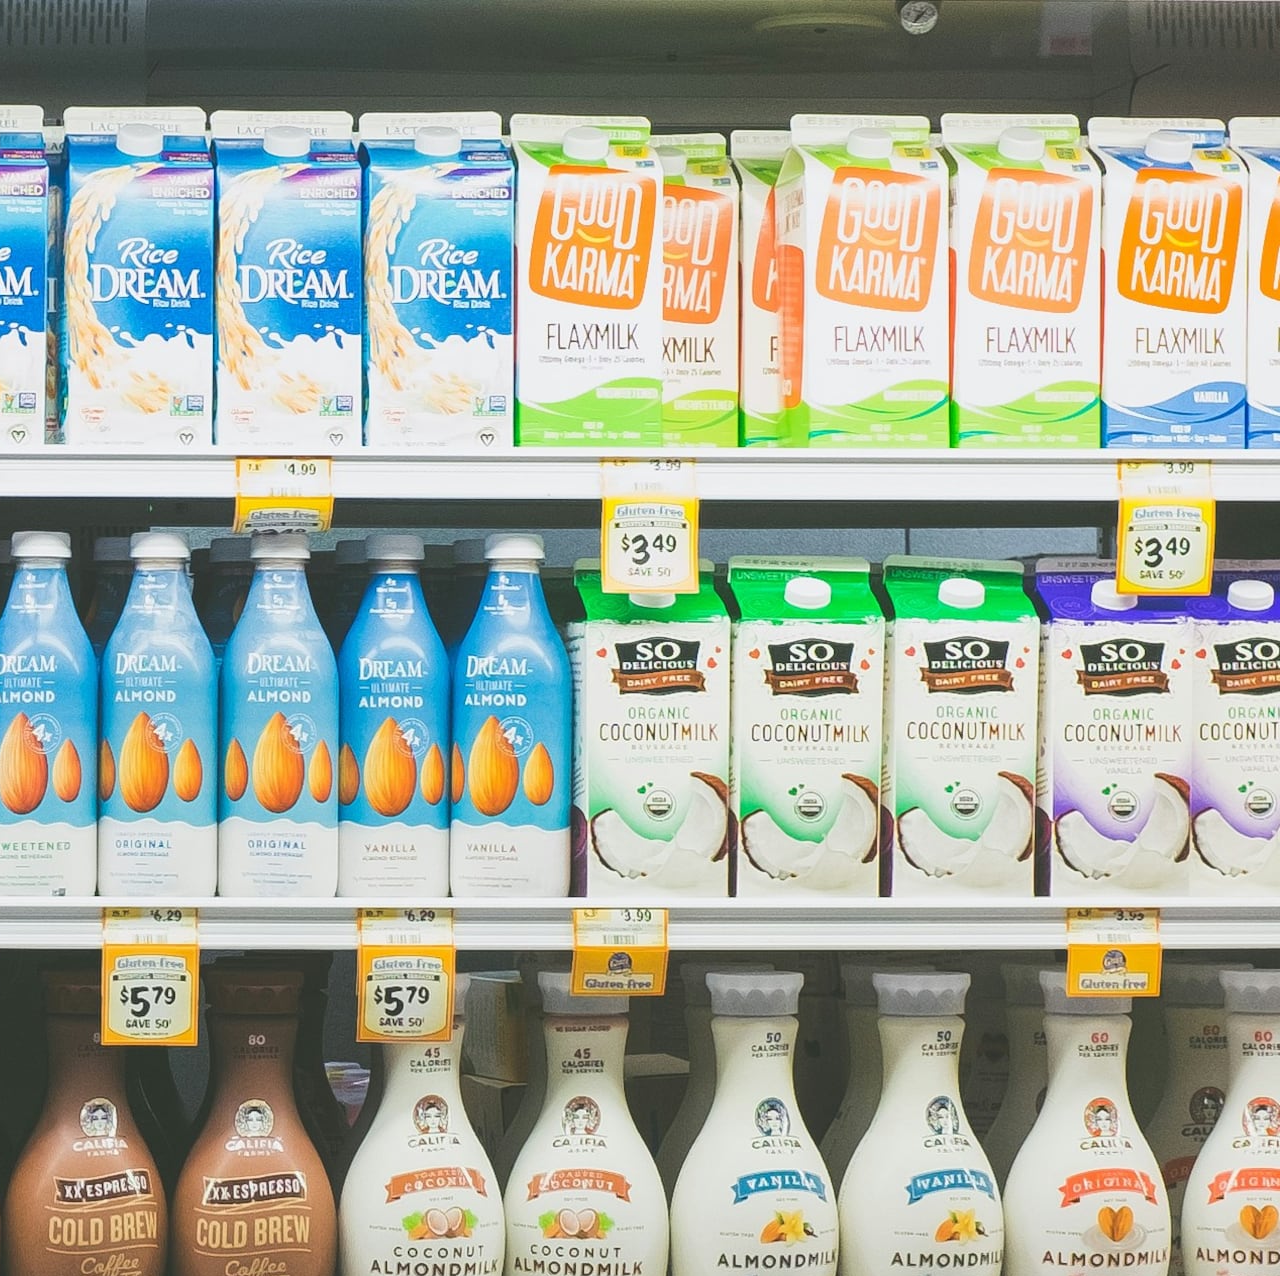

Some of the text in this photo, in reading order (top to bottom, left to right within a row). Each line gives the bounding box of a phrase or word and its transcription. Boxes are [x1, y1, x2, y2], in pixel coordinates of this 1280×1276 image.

[550, 174, 640, 259] GOOD
[543, 241, 640, 300] KARMA
[547, 323, 639, 351] FLAXMILK
[636, 641, 680, 661] SO
[628, 707, 690, 720] ORGANIC
[599, 723, 719, 743] COCONUTMILK
[115, 838, 172, 850] ORIGINAL
[364, 842, 417, 854] VANILLA
[765, 1032, 781, 1044] 50
[1090, 1032, 1109, 1044] 60
[48, 1210, 158, 1244] COLD BREW
[393, 1245, 484, 1259] COCONUT
[1042, 1250, 1170, 1267] ALMONDMILK
